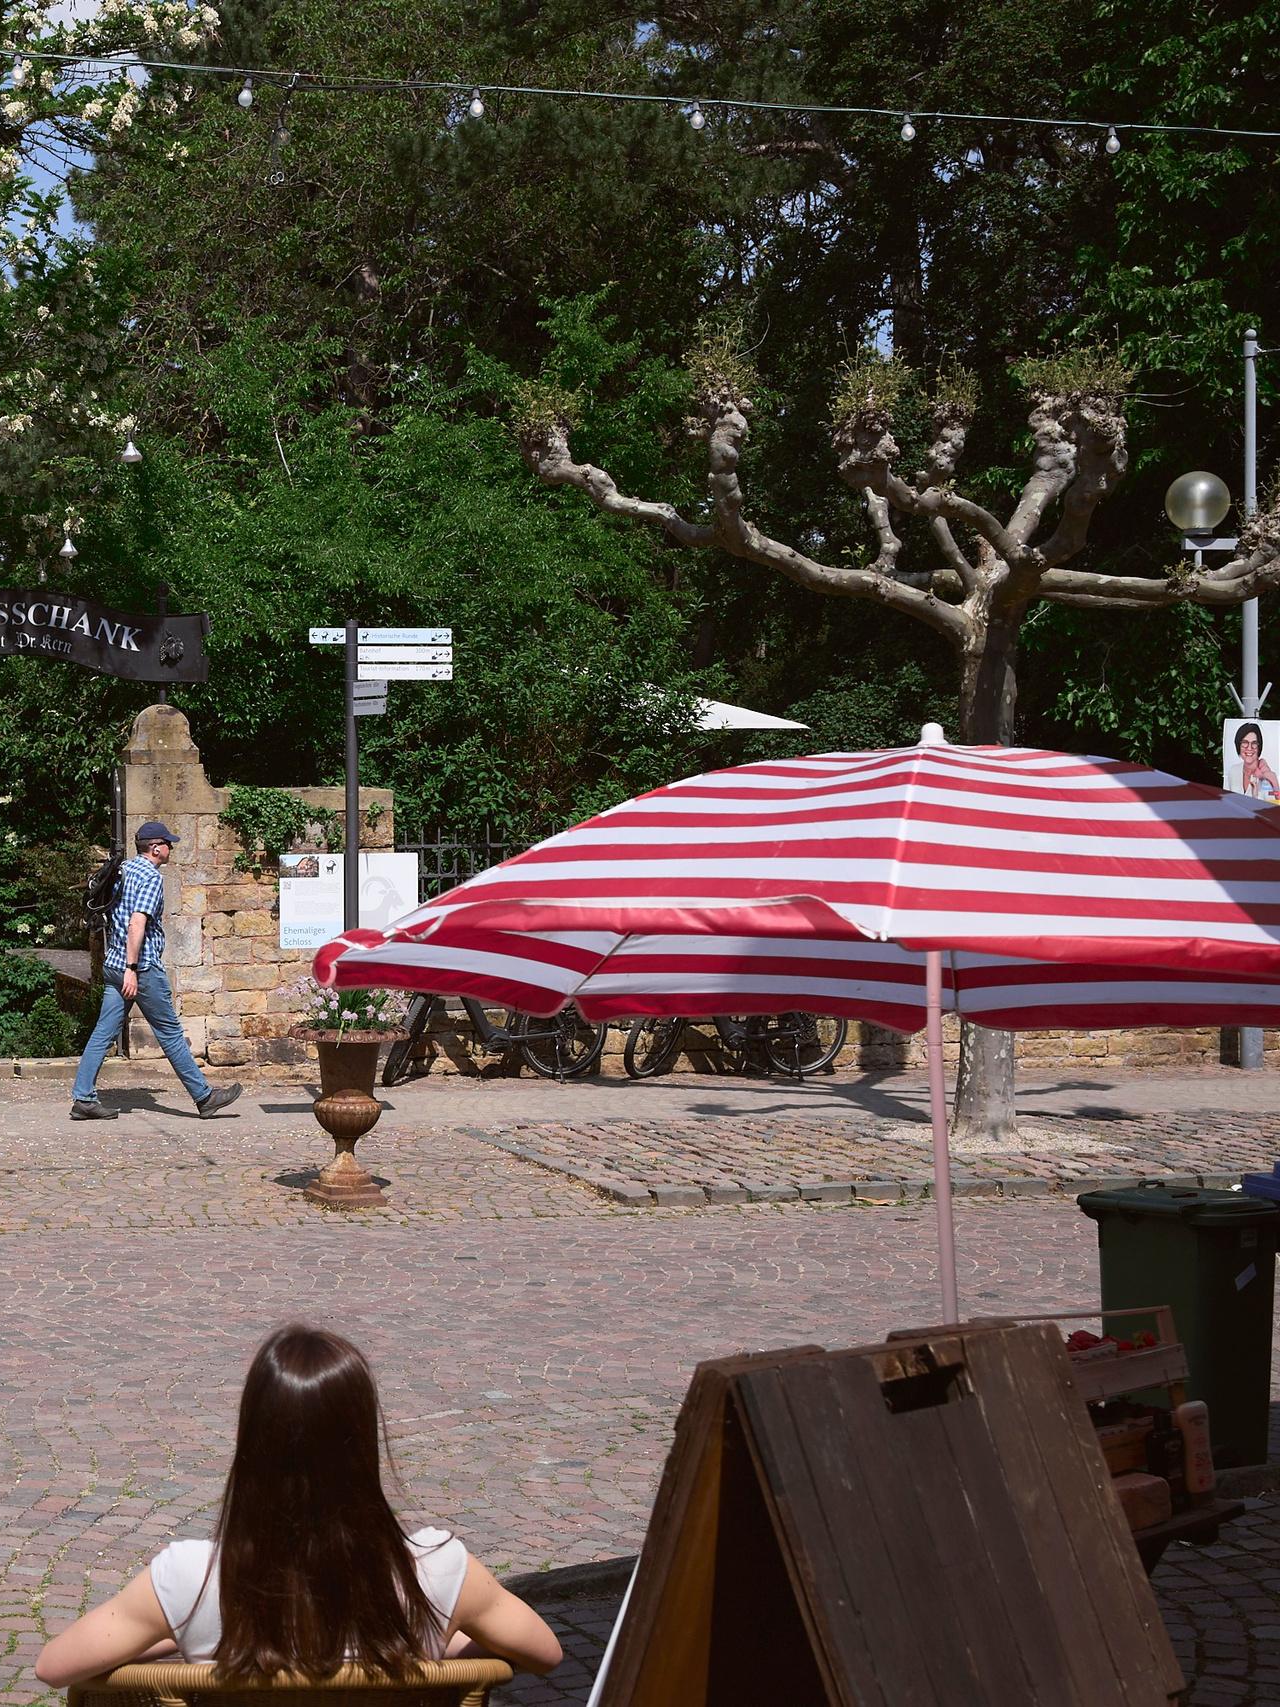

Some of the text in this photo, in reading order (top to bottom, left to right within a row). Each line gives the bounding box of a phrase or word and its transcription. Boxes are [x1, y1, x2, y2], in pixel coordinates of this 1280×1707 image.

[14, 631, 37, 649] Dr.
[39, 634, 73, 654] Kern
[283, 926, 326, 936] Ehemaliges
[283, 937, 313, 946] Schloss
